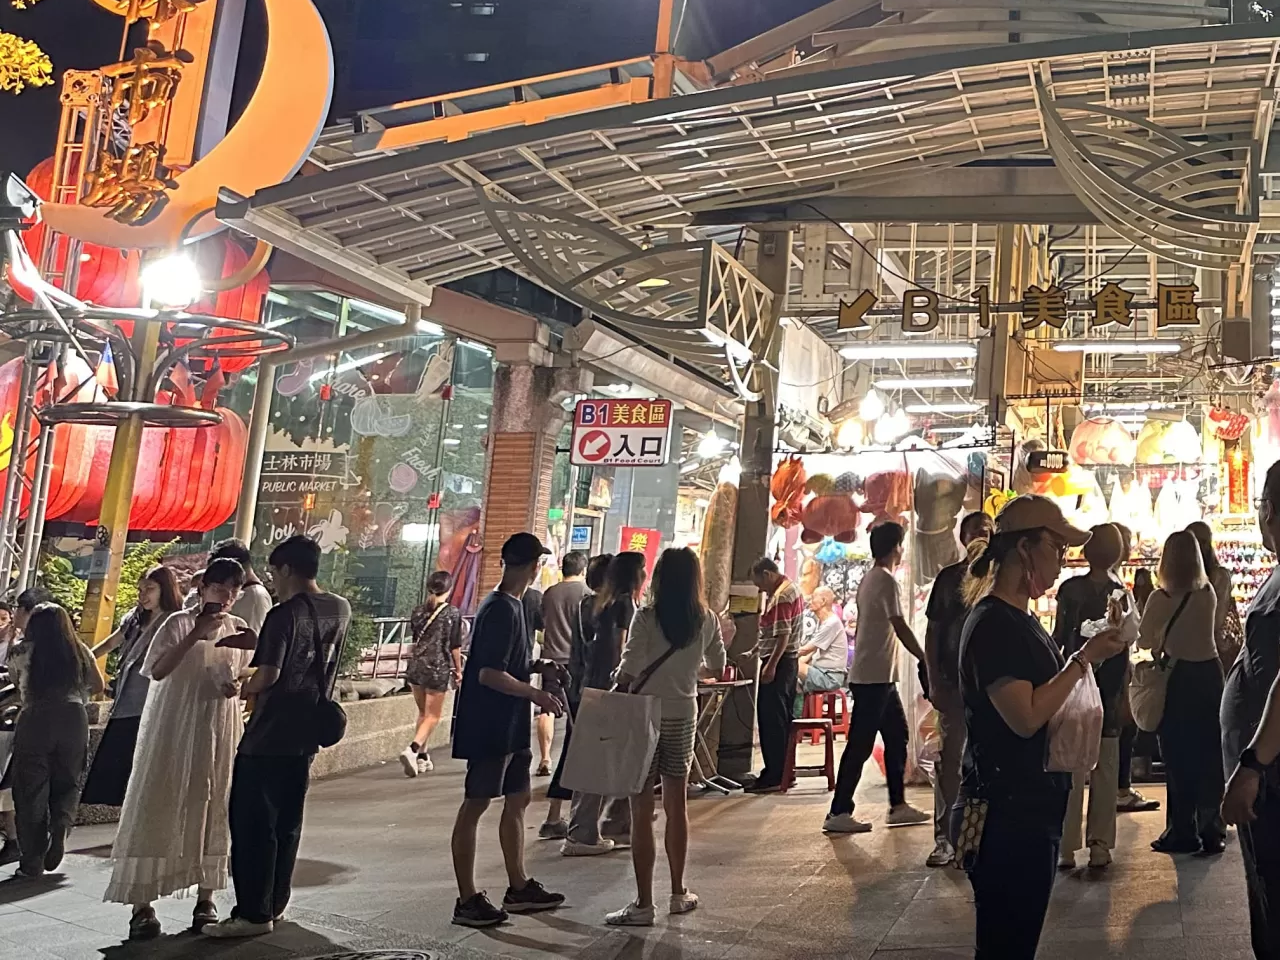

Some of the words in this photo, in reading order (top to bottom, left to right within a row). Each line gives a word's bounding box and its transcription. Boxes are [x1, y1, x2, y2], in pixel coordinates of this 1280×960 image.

[613, 434, 662, 457] 入口
[263, 453, 332, 471] 士林市場
[401, 447, 442, 481] Fresh
[262, 481, 297, 493] PUBLIC
[299, 481, 338, 492] MARKET
[263, 522, 296, 546] Joy
